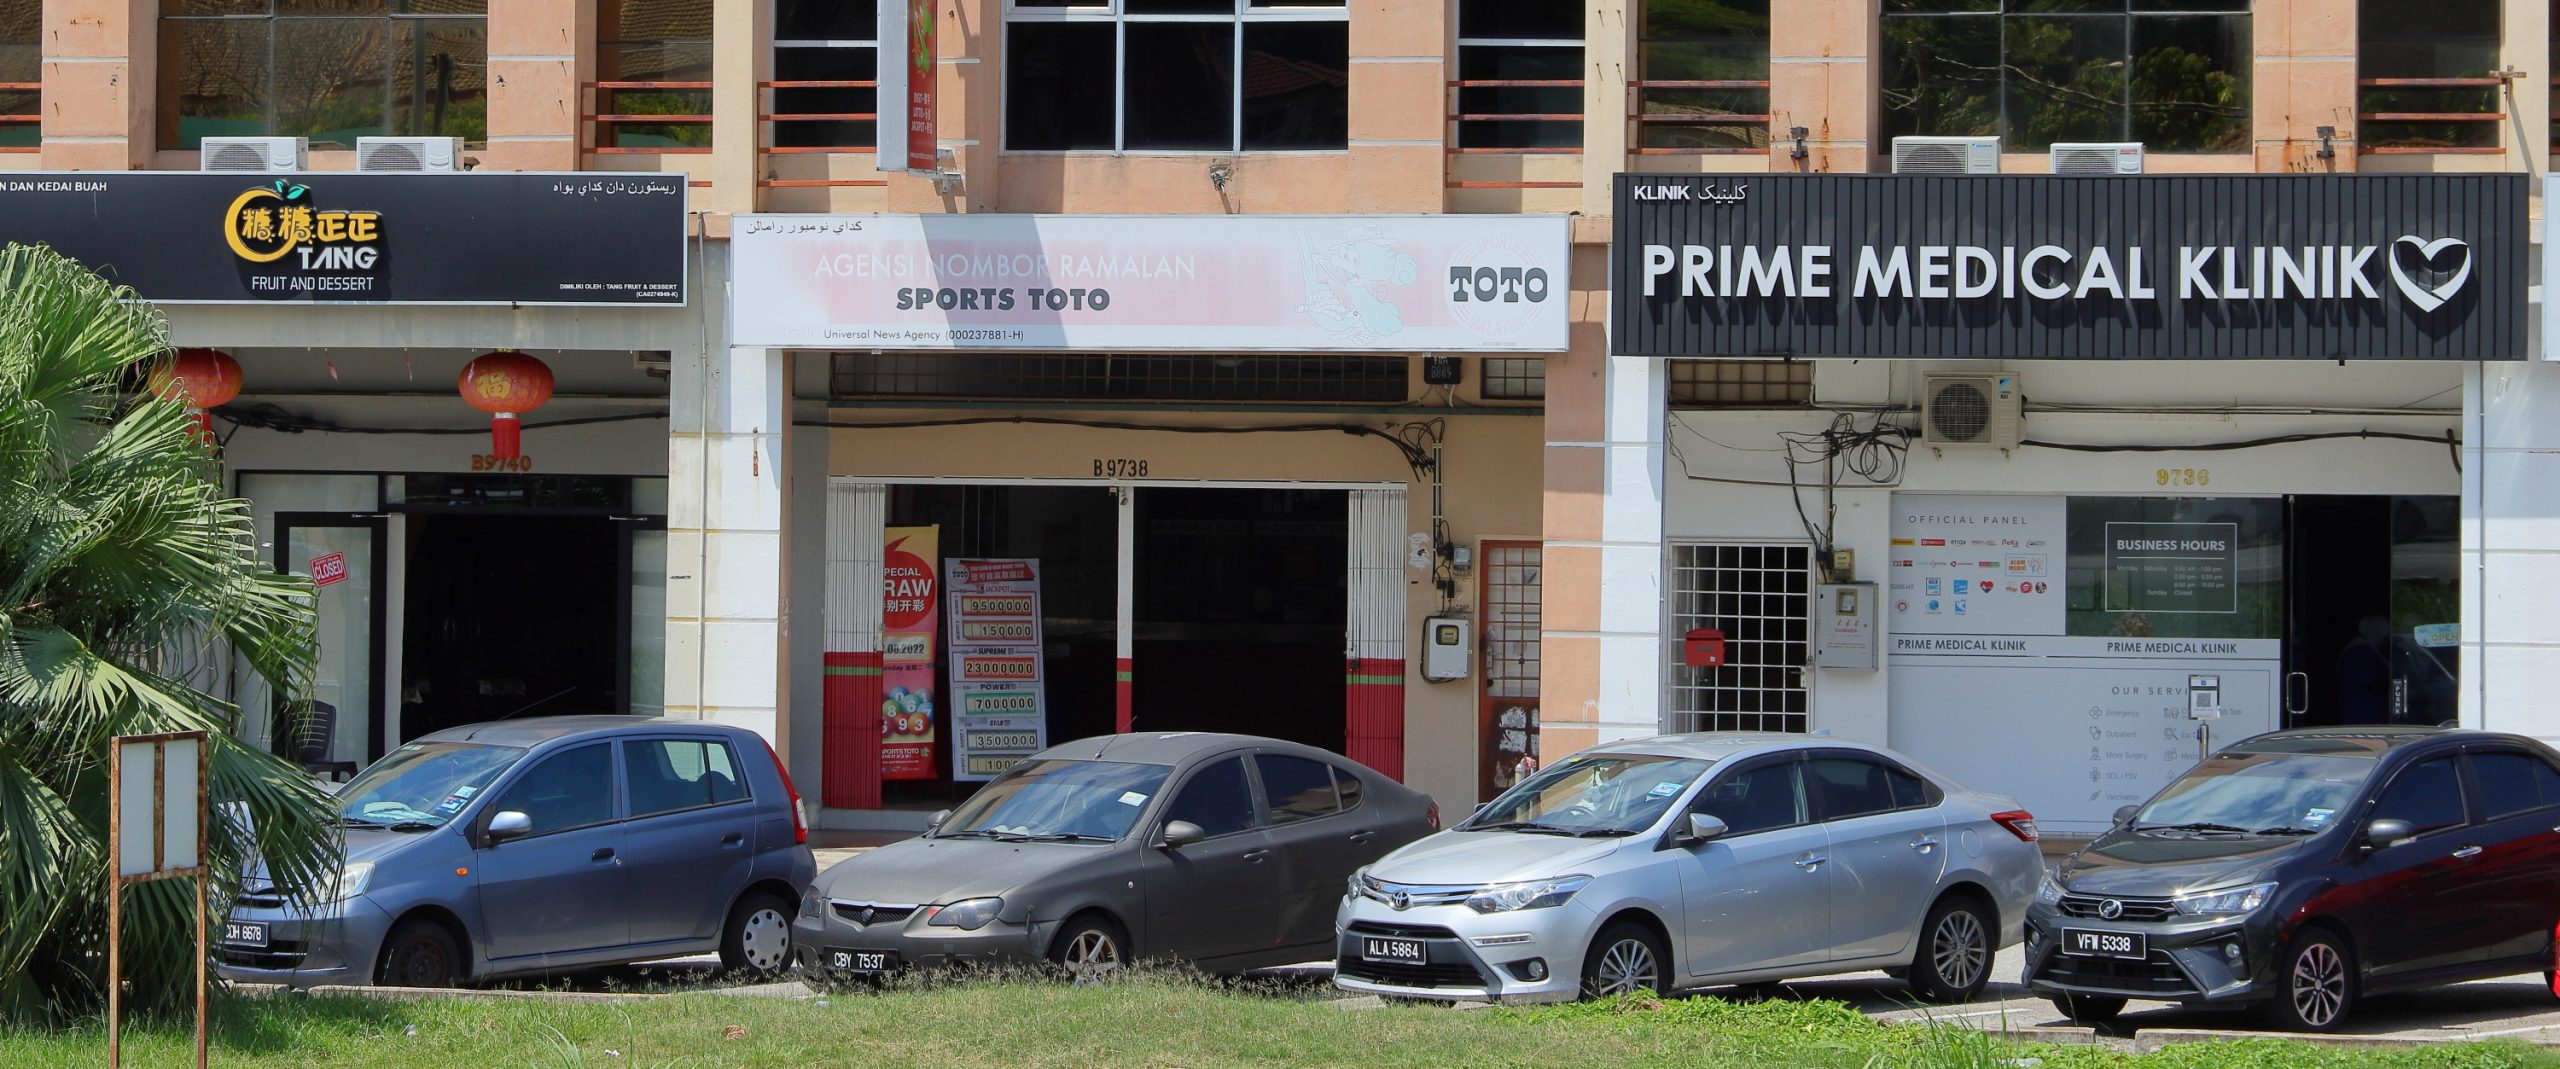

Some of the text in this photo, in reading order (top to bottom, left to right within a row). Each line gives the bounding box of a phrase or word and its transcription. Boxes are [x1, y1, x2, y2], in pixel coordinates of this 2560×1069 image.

[9, 181, 34, 192] DAN
[37, 181, 72, 192] KEDAI
[75, 181, 107, 192] BUAH
[553, 180, 574, 194] بواه
[606, 180, 625, 194] دان
[1634, 185, 1690, 200] KLINIK
[241, 205, 378, 245] 糖糖正正
[791, 221, 829, 235] نومبور
[833, 219, 863, 234] كداي
[298, 246, 379, 270] TANG
[814, 254, 1196, 279] AGENSI NOMBOR RAMALAN
[1643, 244, 2380, 300] PRIME MEDICAL KLINIK
[252, 276, 375, 291] FRUIT AND DESSERT
[1449, 265, 1549, 304] TOTO
[896, 287, 1111, 312] SPORTS TOTO
[824, 328, 871, 341] Universal
[873, 329, 901, 341] News
[903, 329, 941, 343] Agency
[944, 329, 1025, 343] (000237881-H)
[471, 454, 533, 472] B9740
[1093, 459, 1149, 477] B 9738
[1908, 515, 2027, 525] OFFICIAL PANEL
[2116, 539, 2226, 551] BUSINESS HOURS
[314, 560, 344, 580] CLOSED
[884, 567, 921, 577] PECIAL
[2117, 565, 2138, 573] Monday
[2144, 565, 2167, 573] Saturday
[884, 578, 933, 597] RAW
[986, 585, 1010, 593] JACKPOT
[2147, 589, 2167, 597] Sunday
[884, 599, 925, 612] 别开彩
[2431, 632, 2457, 641] OPEN
[1898, 638, 2027, 651] PRIME MEDICAL KLINIK
[2107, 642, 2237, 654] PRIME MEDICAL KLINIK
[883, 664, 904, 672] esday
[2111, 686, 2188, 695] OUR SERVI
[887, 705, 897, 717] 8
[907, 701, 917, 713] 6
[2106, 709, 2140, 718] Emergency
[898, 718, 908, 731] 9
[914, 718, 924, 731] 3
[2106, 730, 2137, 739] Outpatient
[904, 747, 920, 755] TOTO
[2124, 752, 2148, 761] Surgery
[2106, 793, 2140, 801] Vaccination
[242, 925, 262, 941] 6678
[2077, 933, 2131, 951] VFW 5338
[1369, 940, 1419, 958] ALA 5864
[834, 952, 885, 969] CBY 7537
